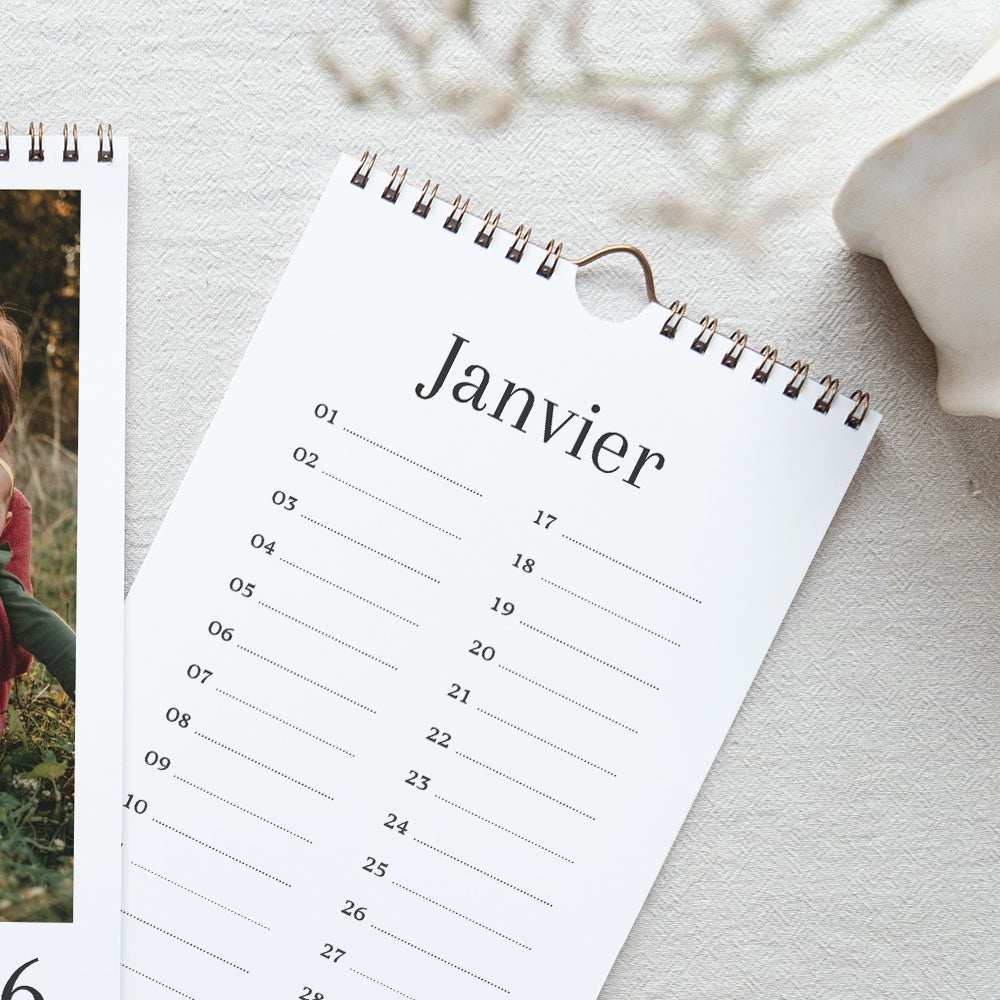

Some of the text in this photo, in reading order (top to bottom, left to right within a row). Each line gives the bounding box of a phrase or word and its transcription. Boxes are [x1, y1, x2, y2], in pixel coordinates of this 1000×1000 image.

[314, 403, 338, 425] 01
[414, 333, 666, 489] Janvier
[292, 446, 319, 469] 02
[271, 490, 298, 511] 03
[532, 509, 558, 530] 17
[250, 533, 276, 556] 04
[511, 553, 536, 574] 18
[229, 577, 256, 598] 05
[490, 596, 515, 616] 19
[208, 620, 235, 642] 06
[468, 639, 496, 662] 20
[186, 663, 214, 684] 07
[447, 683, 471, 705] 21
[165, 707, 192, 729] 08
[425, 726, 452, 749] 22
[144, 750, 171, 771] 09
[404, 769, 432, 791] 23
[123, 793, 148, 815] 10
[383, 813, 409, 836] 24
[362, 856, 389, 878] 25
[340, 899, 368, 922] 26
[319, 943, 347, 963] 27
